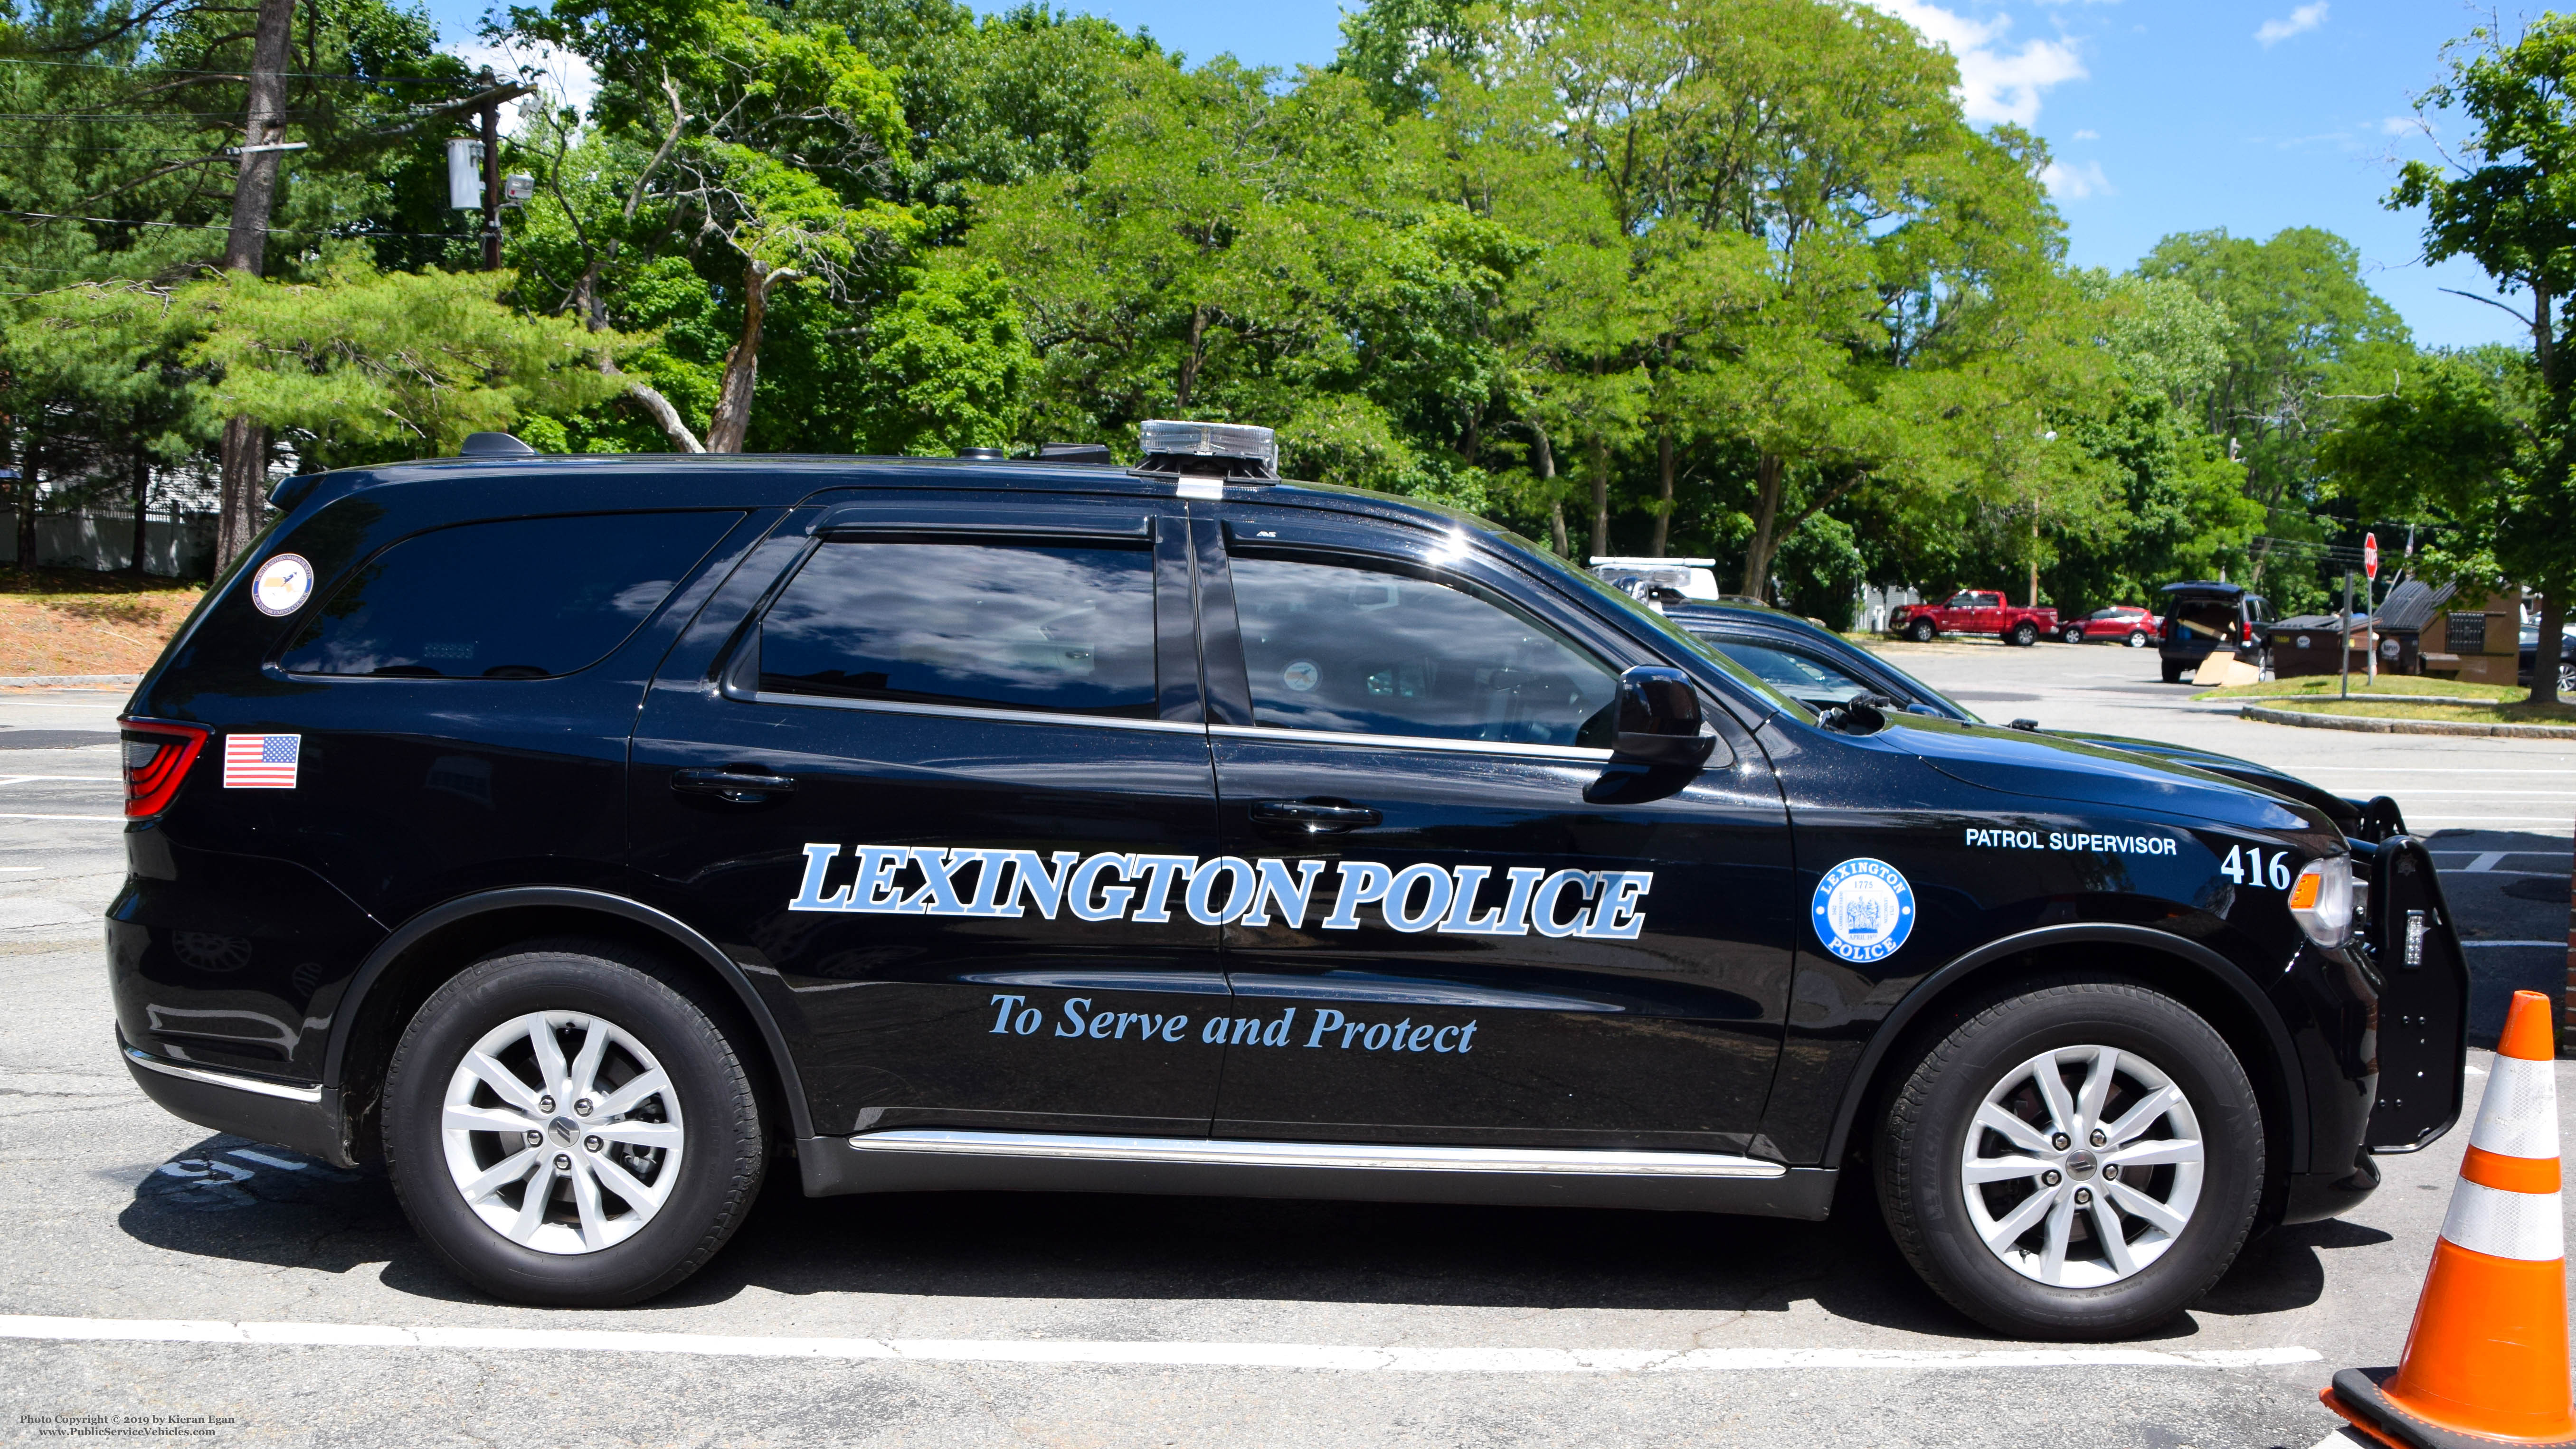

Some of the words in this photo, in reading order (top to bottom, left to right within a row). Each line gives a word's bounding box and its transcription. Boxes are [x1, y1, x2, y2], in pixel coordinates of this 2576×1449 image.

[2366, 547, 2376, 566] STOP
[292, 591, 309, 610] COUNCIL
[1966, 828, 2044, 848] PATROL
[2050, 832, 2177, 855] SUPERVISOR
[1820, 862, 1905, 895] LEXINGTON
[2221, 845, 2291, 890] 416
[788, 843, 1325, 929] LEXINGTON
[1322, 860, 1653, 939] POLICE
[1854, 881, 1873, 889] 1775
[1828, 936, 1896, 960] POLICE
[990, 995, 1042, 1035] To
[1055, 998, 1188, 1042] Serve
[1202, 1006, 1295, 1046] and
[1302, 1009, 1477, 1054] Protect
